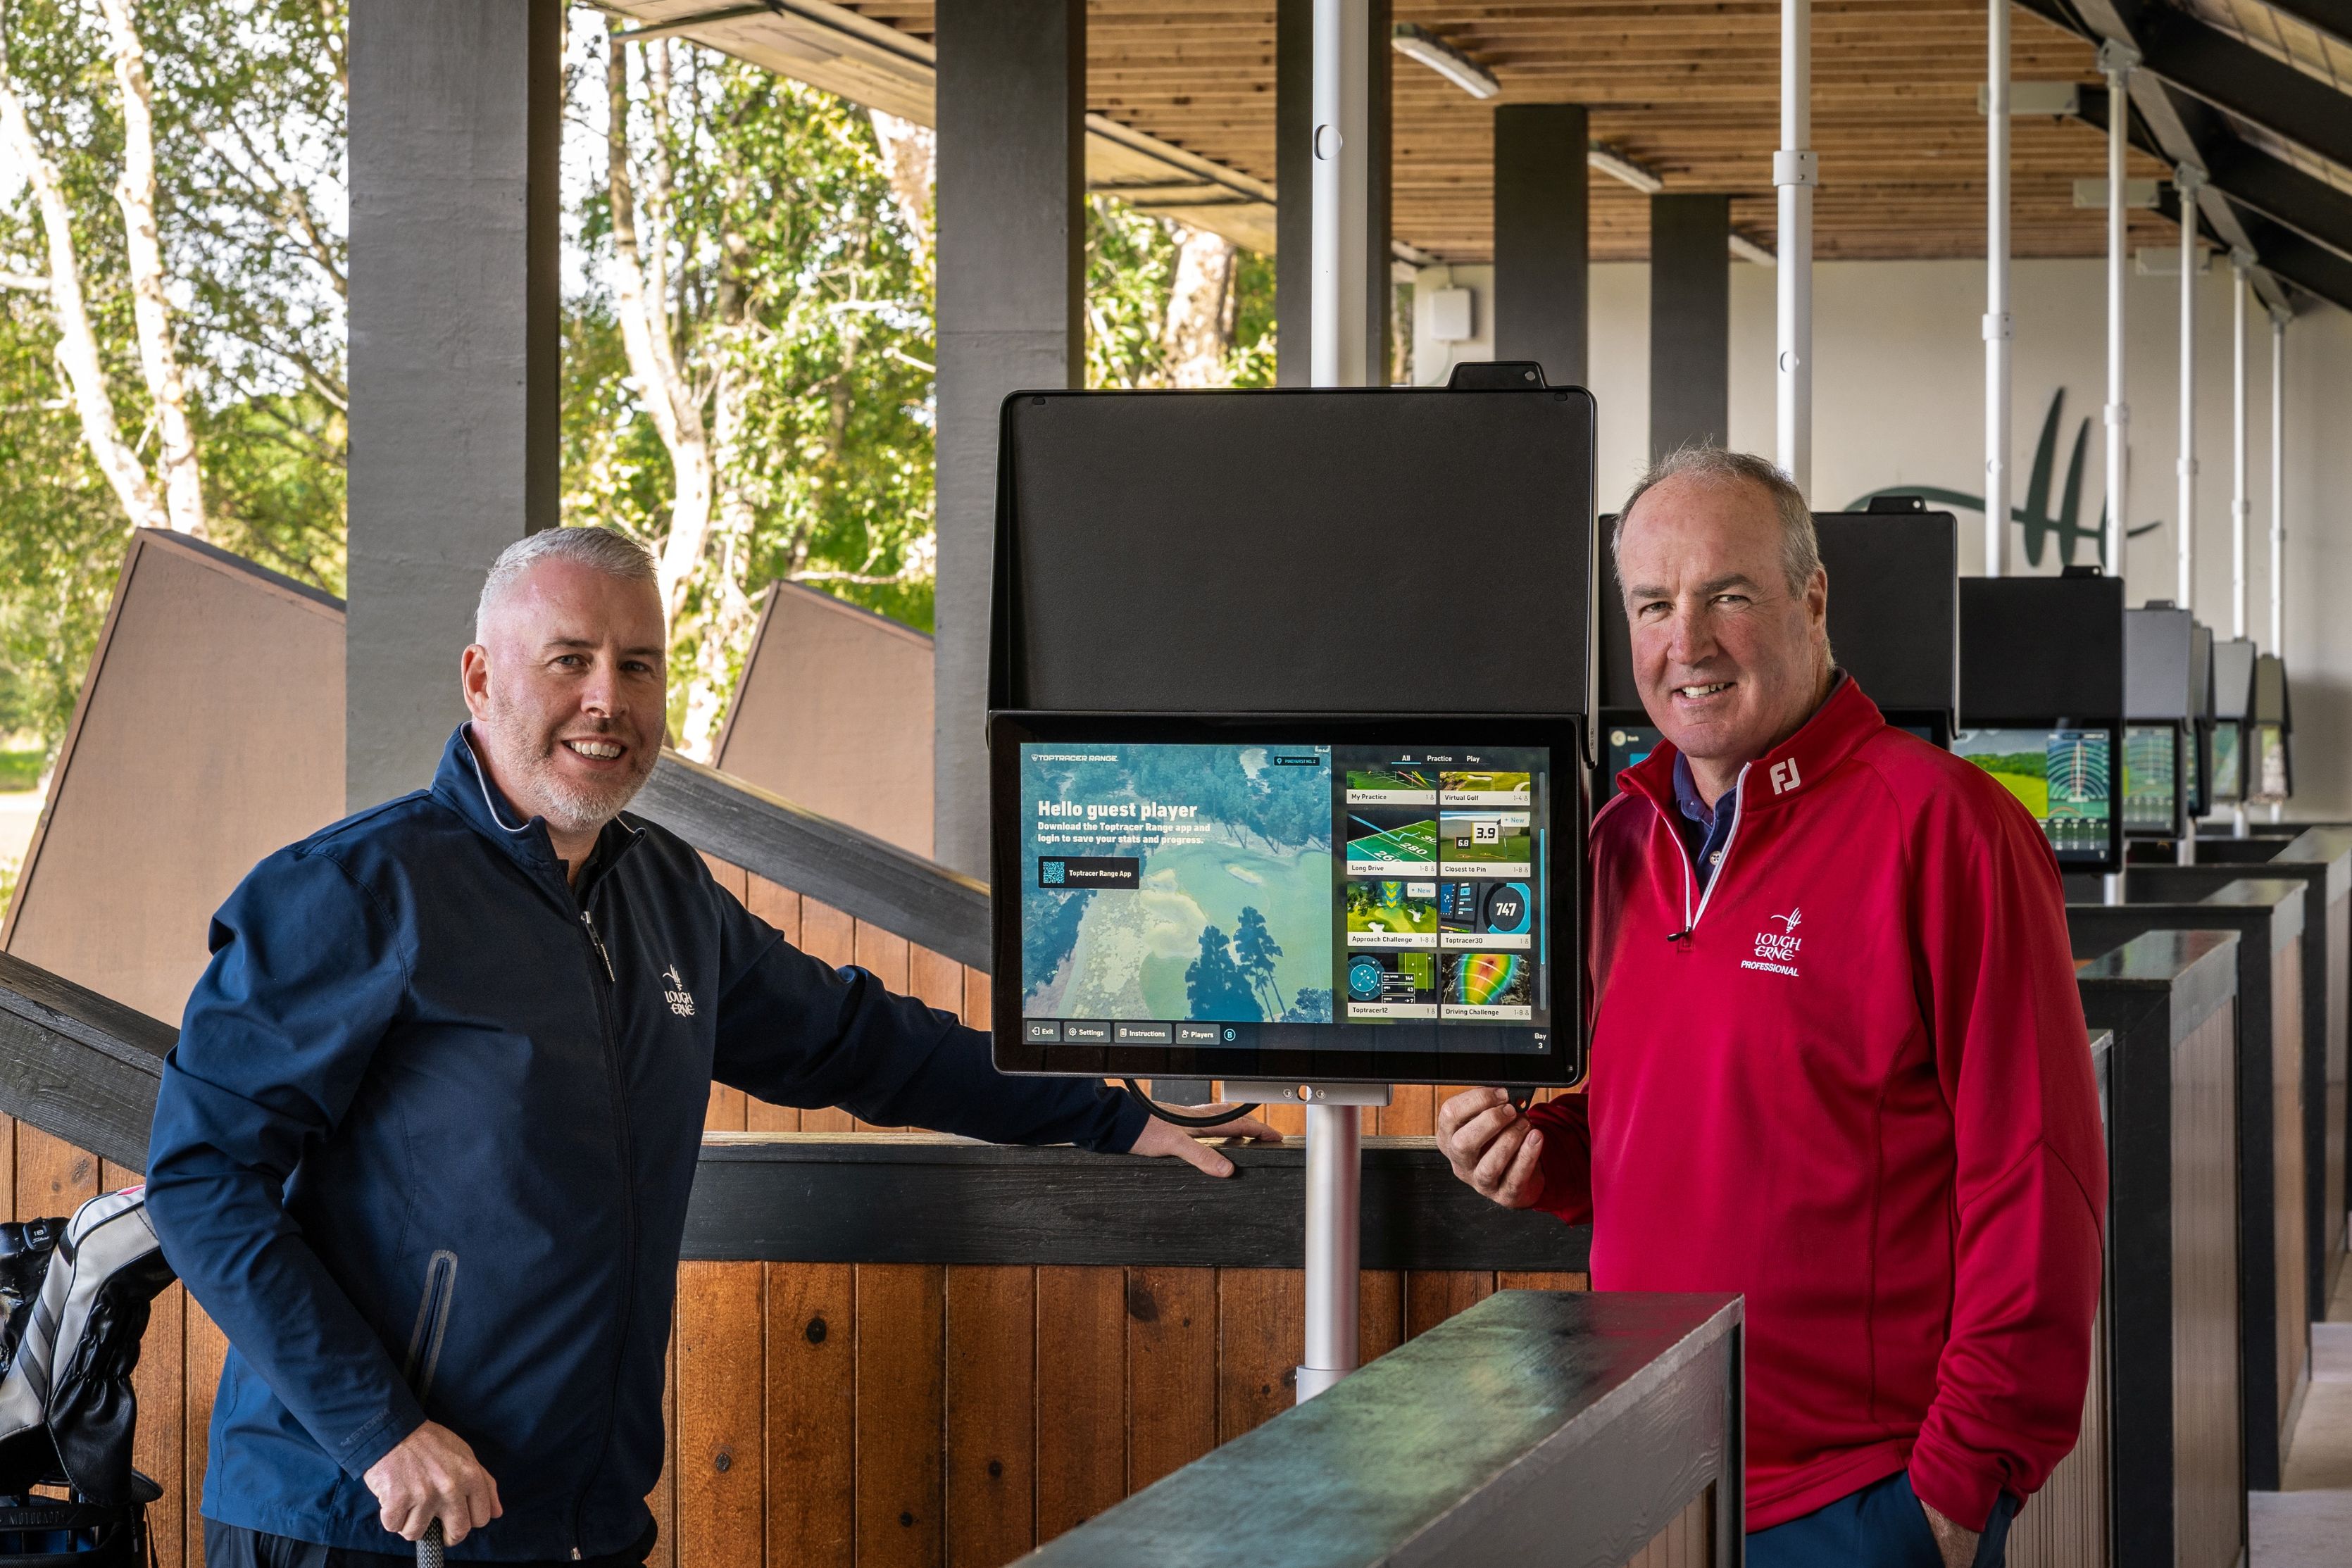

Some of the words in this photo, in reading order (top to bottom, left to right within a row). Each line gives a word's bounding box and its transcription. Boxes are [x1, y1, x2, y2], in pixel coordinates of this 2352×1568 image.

[1466, 755, 1480, 763] Play
[1770, 758, 1801, 795] FJ
[1038, 801, 1082, 817] Hello
[1087, 802, 1136, 820] guest
[1141, 801, 1198, 822] player
[1037, 822, 1082, 831] Download
[1083, 822, 1098, 831] the
[1099, 822, 1144, 832] Toptracer
[1145, 823, 1173, 833] Range
[1175, 825, 1191, 834] app
[1476, 827, 1496, 839] 3.9
[1037, 834, 1060, 844] login
[1095, 836, 1116, 845] your
[1118, 835, 1141, 843] stats
[1142, 835, 1159, 843] and
[1161, 836, 1204, 846] progress.
[1399, 842, 1428, 855] 280
[1069, 870, 1099, 878] Toptracer
[1099, 870, 1118, 878] Range
[1496, 903, 1517, 917] 747
[1755, 932, 1801, 951] LOUGH
[1754, 946, 1795, 961] ERNE
[1741, 960, 1799, 977] PROFESSIONAL
[664, 991, 694, 1005] LOUGH
[670, 1003, 695, 1017] ERNE
[1078, 1029, 1104, 1037] Settings
[1190, 1031, 1214, 1039] Players
[1534, 1032, 1546, 1041] Bay
[350, 1407, 390, 1442] STORM
